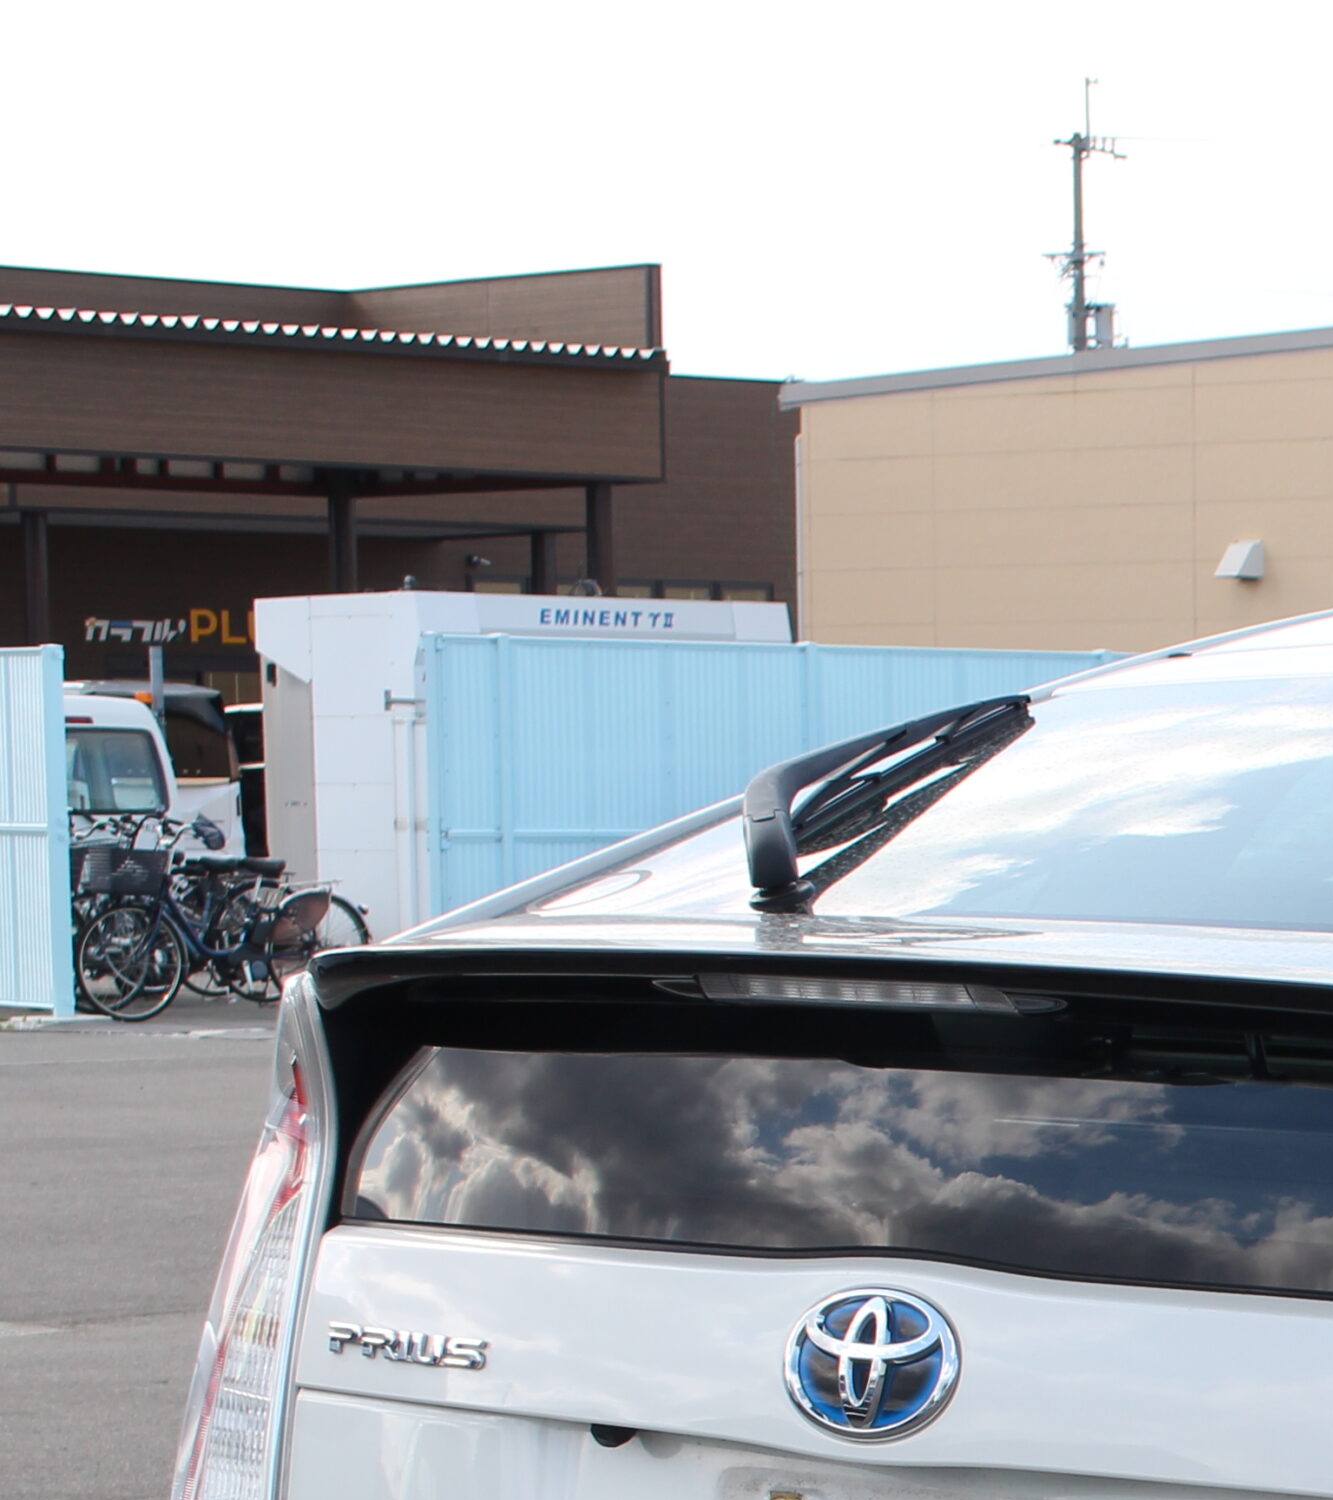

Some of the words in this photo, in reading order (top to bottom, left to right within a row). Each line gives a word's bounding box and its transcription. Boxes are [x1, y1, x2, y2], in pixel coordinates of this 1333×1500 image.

[190, 608, 254, 644] PL
[540, 608, 642, 627] EMINENT
[329, 1321, 489, 1370] PRIUS
